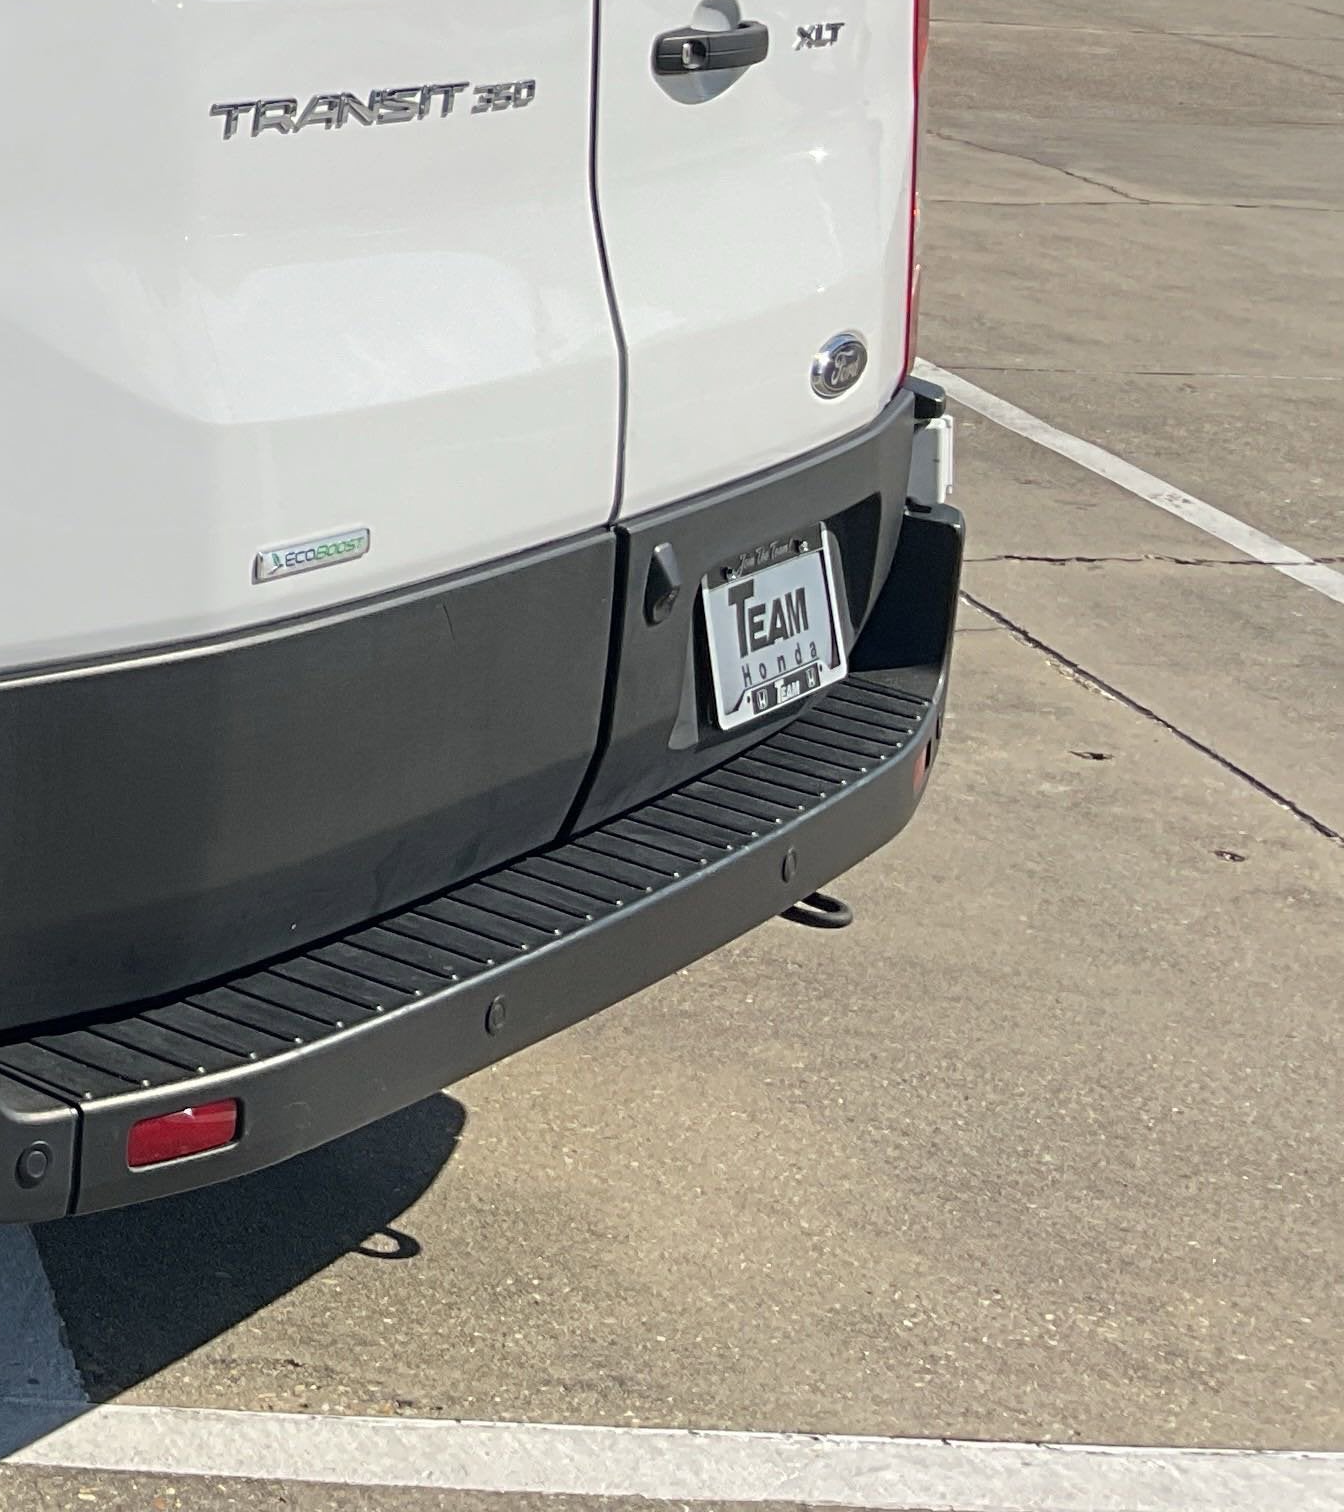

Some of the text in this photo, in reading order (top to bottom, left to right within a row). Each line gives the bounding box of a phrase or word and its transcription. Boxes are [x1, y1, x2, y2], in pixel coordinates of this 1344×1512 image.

[794, 22, 845, 51] XLT
[209, 79, 536, 140] TRANSIT 350
[831, 350, 861, 385] Ford
[728, 578, 809, 659] TEAM
[741, 641, 819, 688] Honda
[774, 678, 801, 705] TEAM
